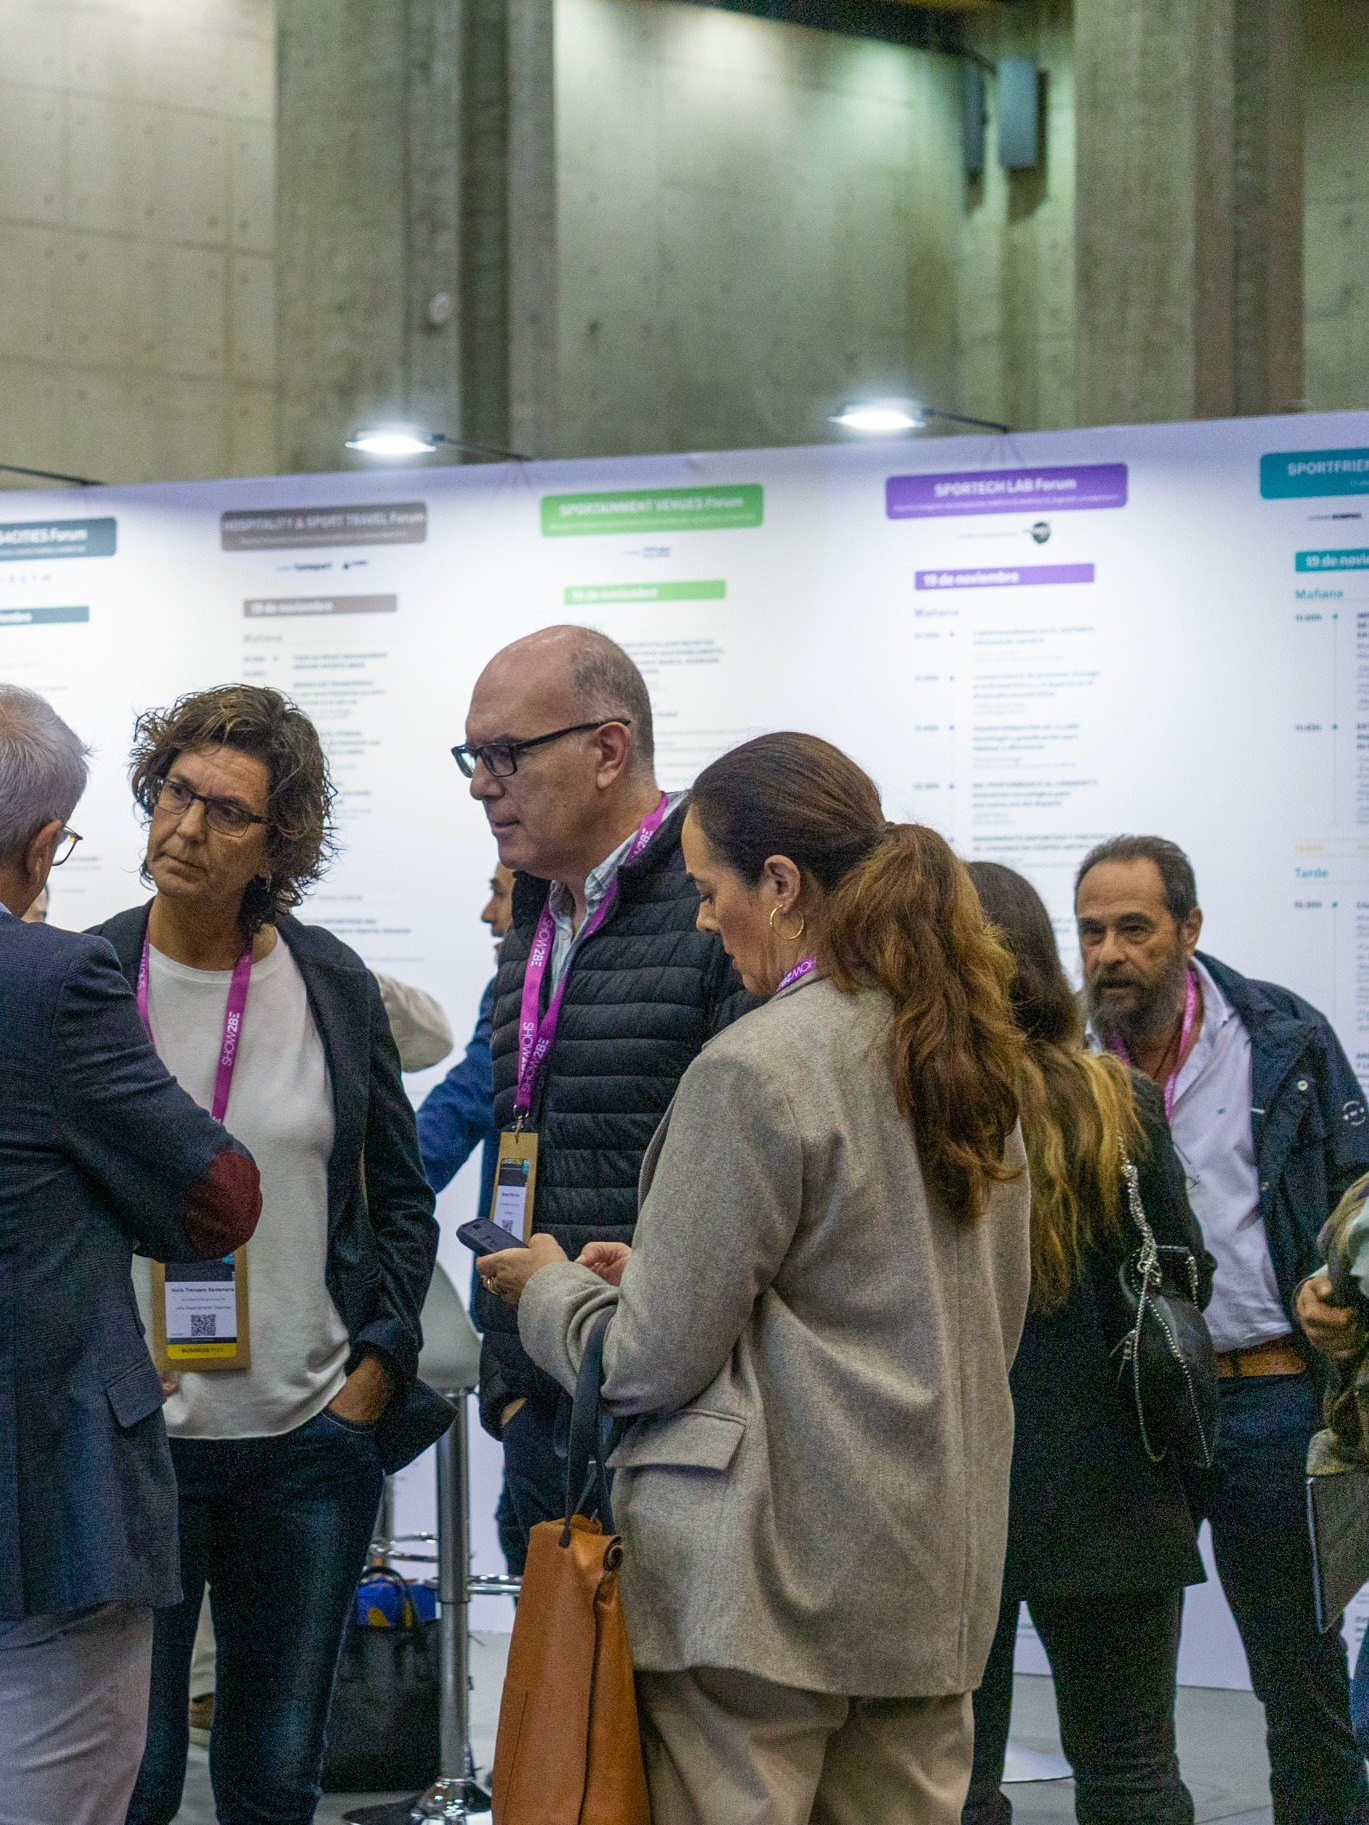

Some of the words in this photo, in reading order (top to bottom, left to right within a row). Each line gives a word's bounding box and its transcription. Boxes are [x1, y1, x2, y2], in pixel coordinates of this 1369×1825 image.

[956, 570, 1019, 584] noviembre
[529, 916, 553, 968] SHOW2BE
[221, 1011, 240, 1067] SHOW2BE
